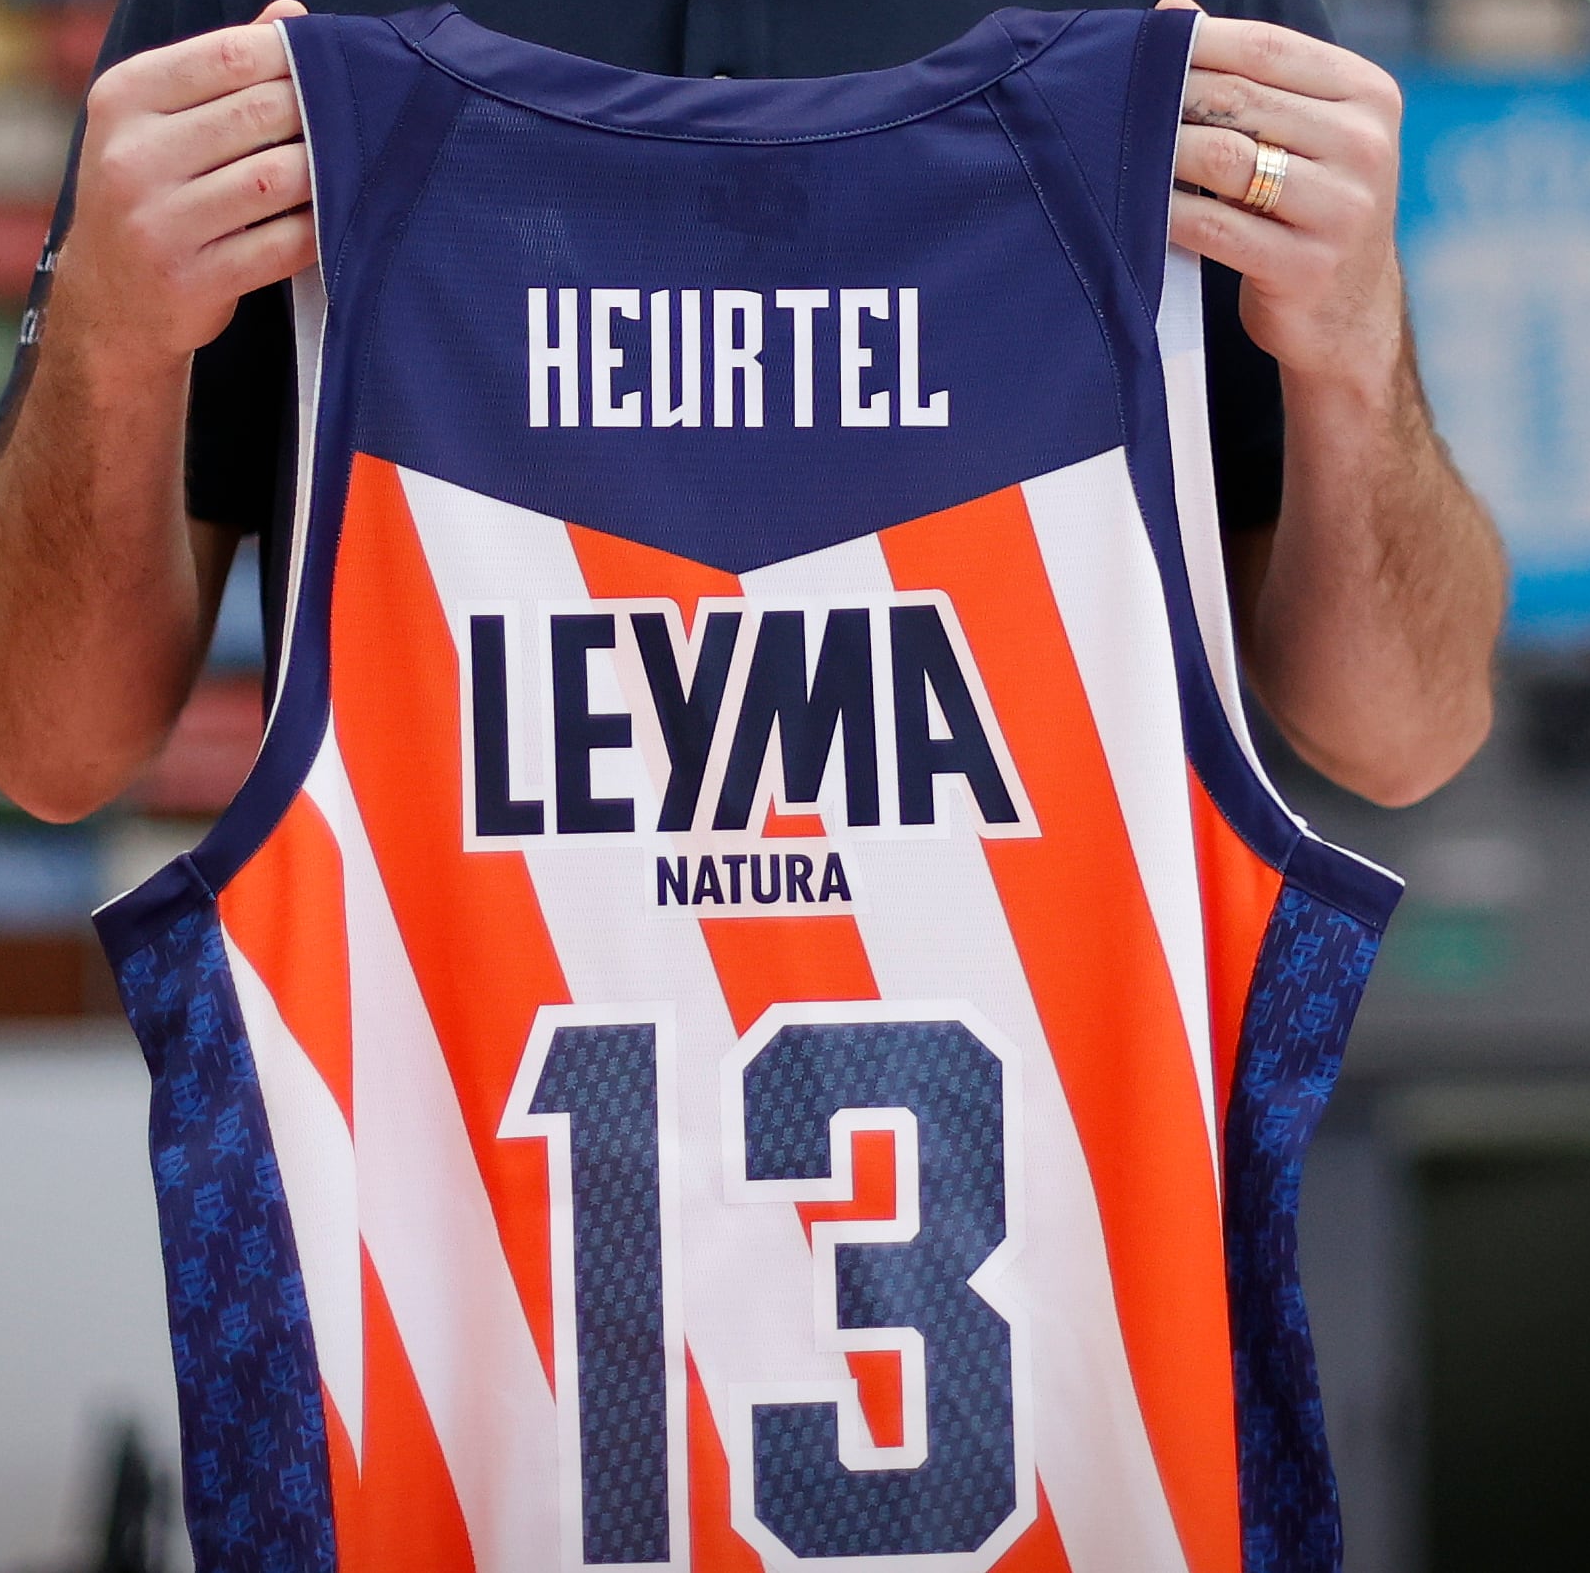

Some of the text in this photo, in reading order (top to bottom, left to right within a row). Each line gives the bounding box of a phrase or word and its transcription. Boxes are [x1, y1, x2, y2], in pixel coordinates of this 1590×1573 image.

[527, 287, 950, 429] HEURTEL
[468, 603, 1020, 837] LEYMA
[655, 852, 852, 906] NATURA
[510, 1012, 1028, 1567] 13
